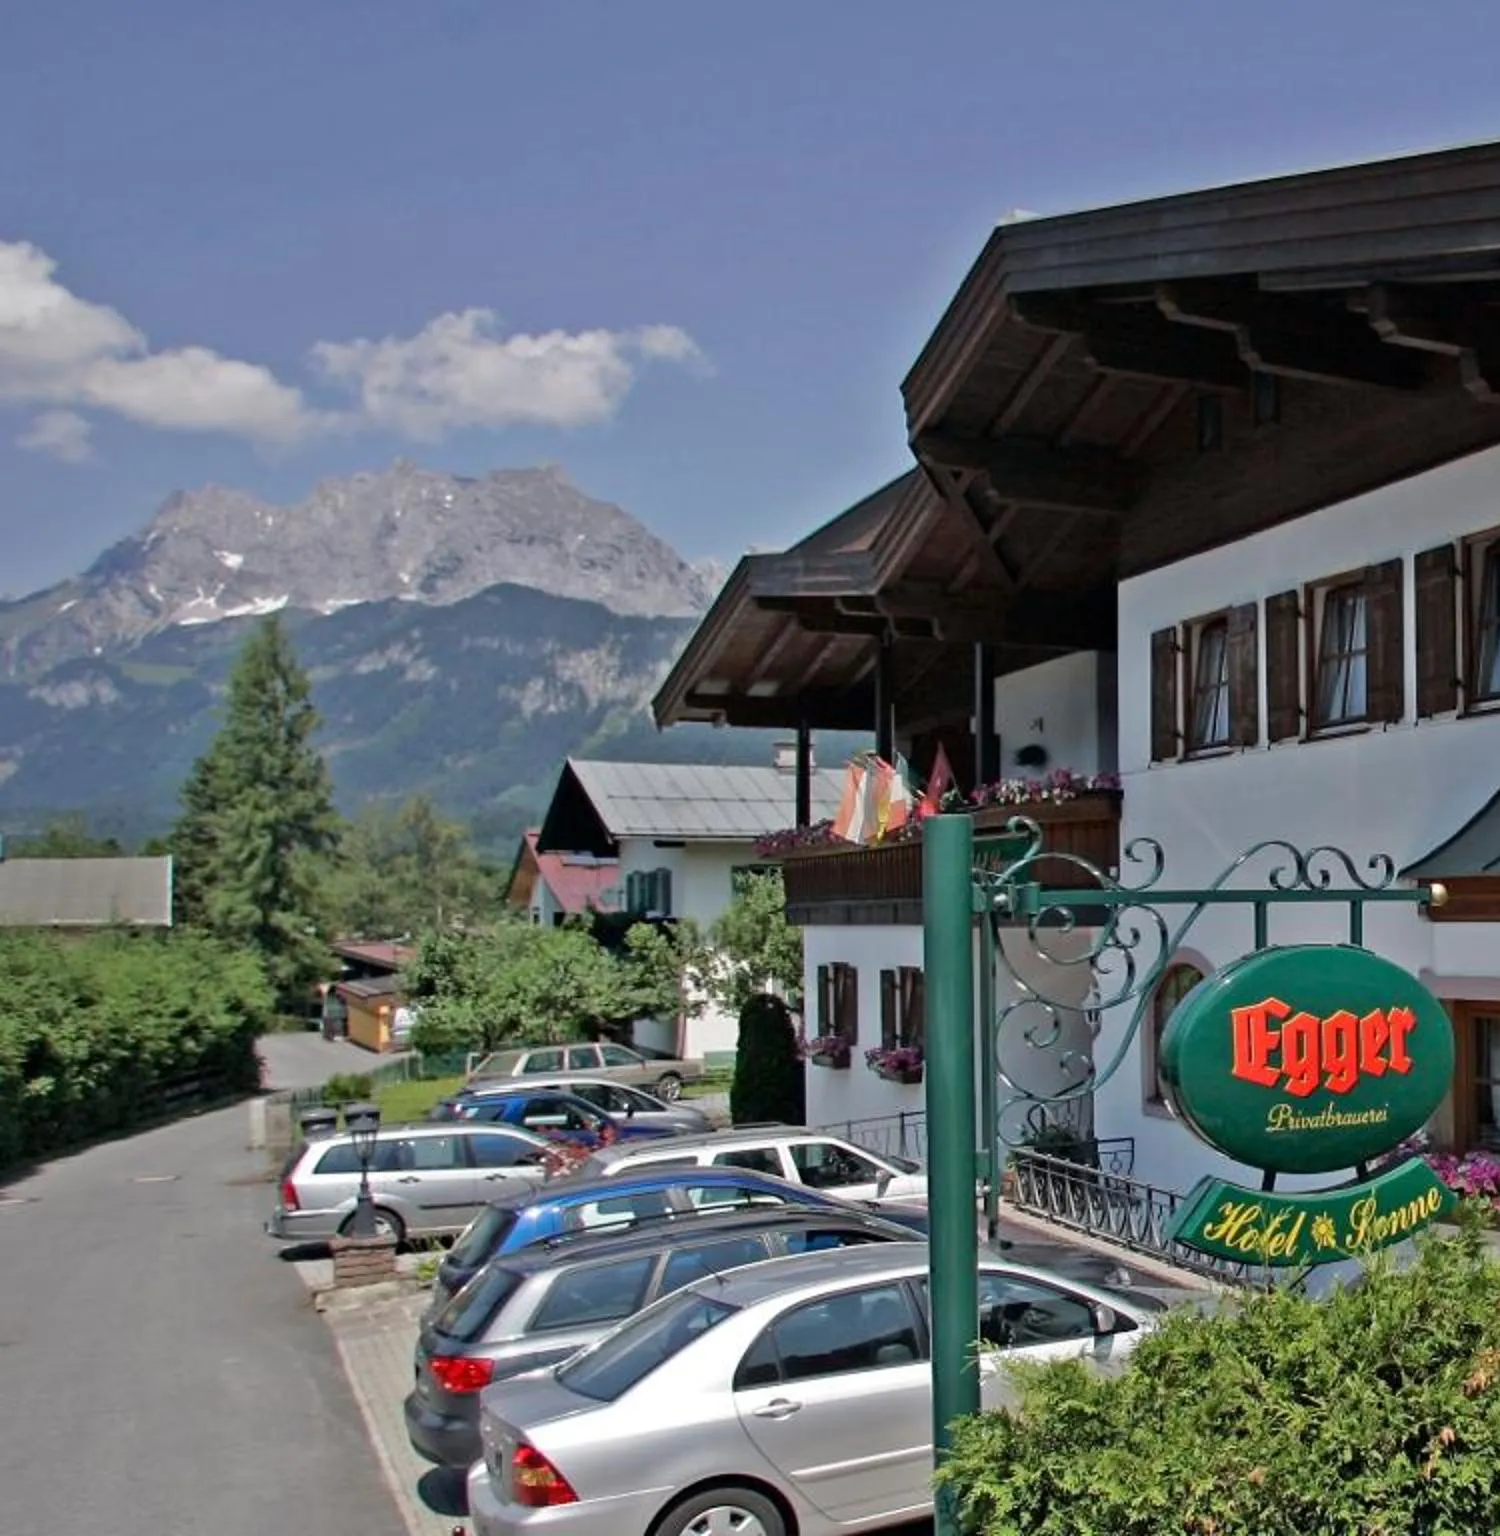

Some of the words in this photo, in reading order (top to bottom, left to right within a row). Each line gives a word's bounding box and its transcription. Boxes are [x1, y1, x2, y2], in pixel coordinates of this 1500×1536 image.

[1230, 996, 1418, 1098] Egger
[1265, 1101, 1389, 1133] Privatbrauerei
[1203, 1201, 1307, 1257] Hotel
[1345, 1186, 1443, 1249] Sonne
